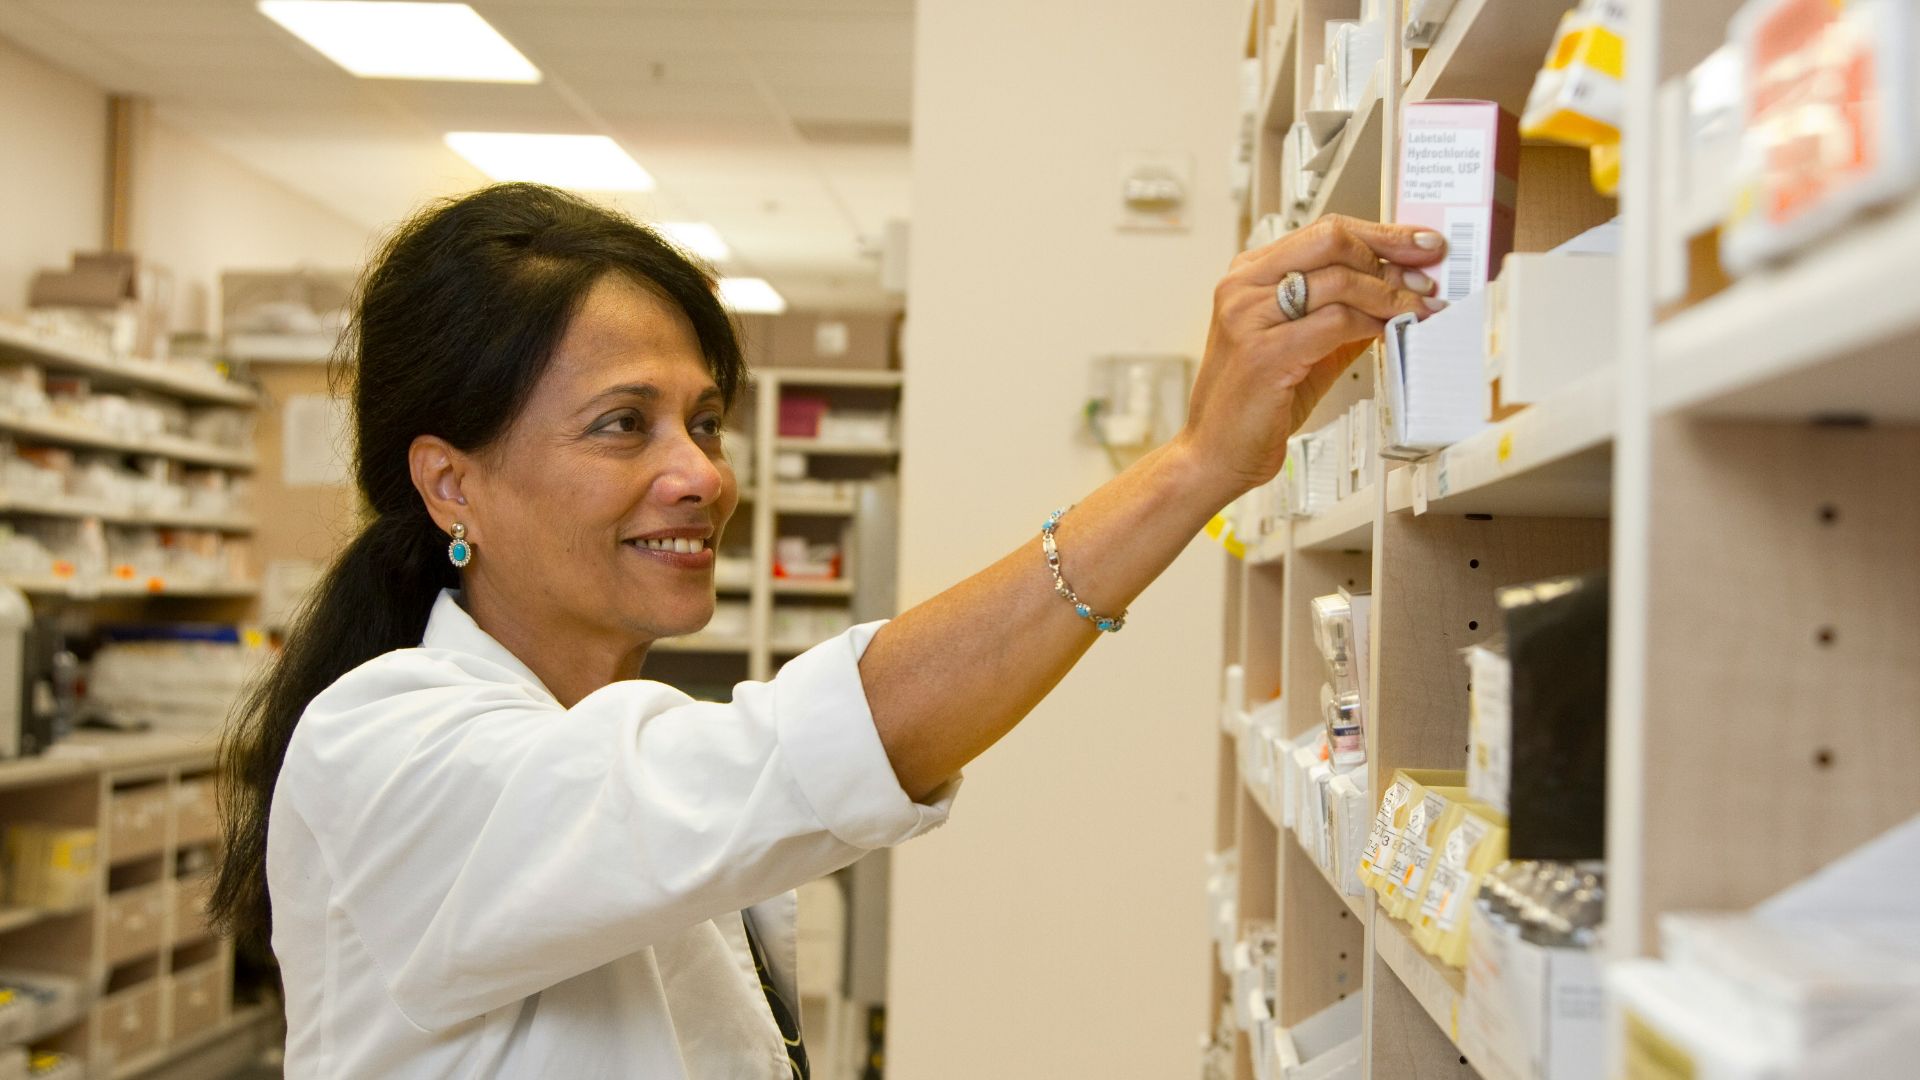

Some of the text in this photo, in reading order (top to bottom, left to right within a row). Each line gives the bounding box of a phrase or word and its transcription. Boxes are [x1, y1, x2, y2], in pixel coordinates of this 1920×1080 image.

[1408, 132, 1456, 143] Labetalol
[1408, 147, 1481, 160] Hydrochloride
[1406, 162, 1481, 175] Injection, USP
